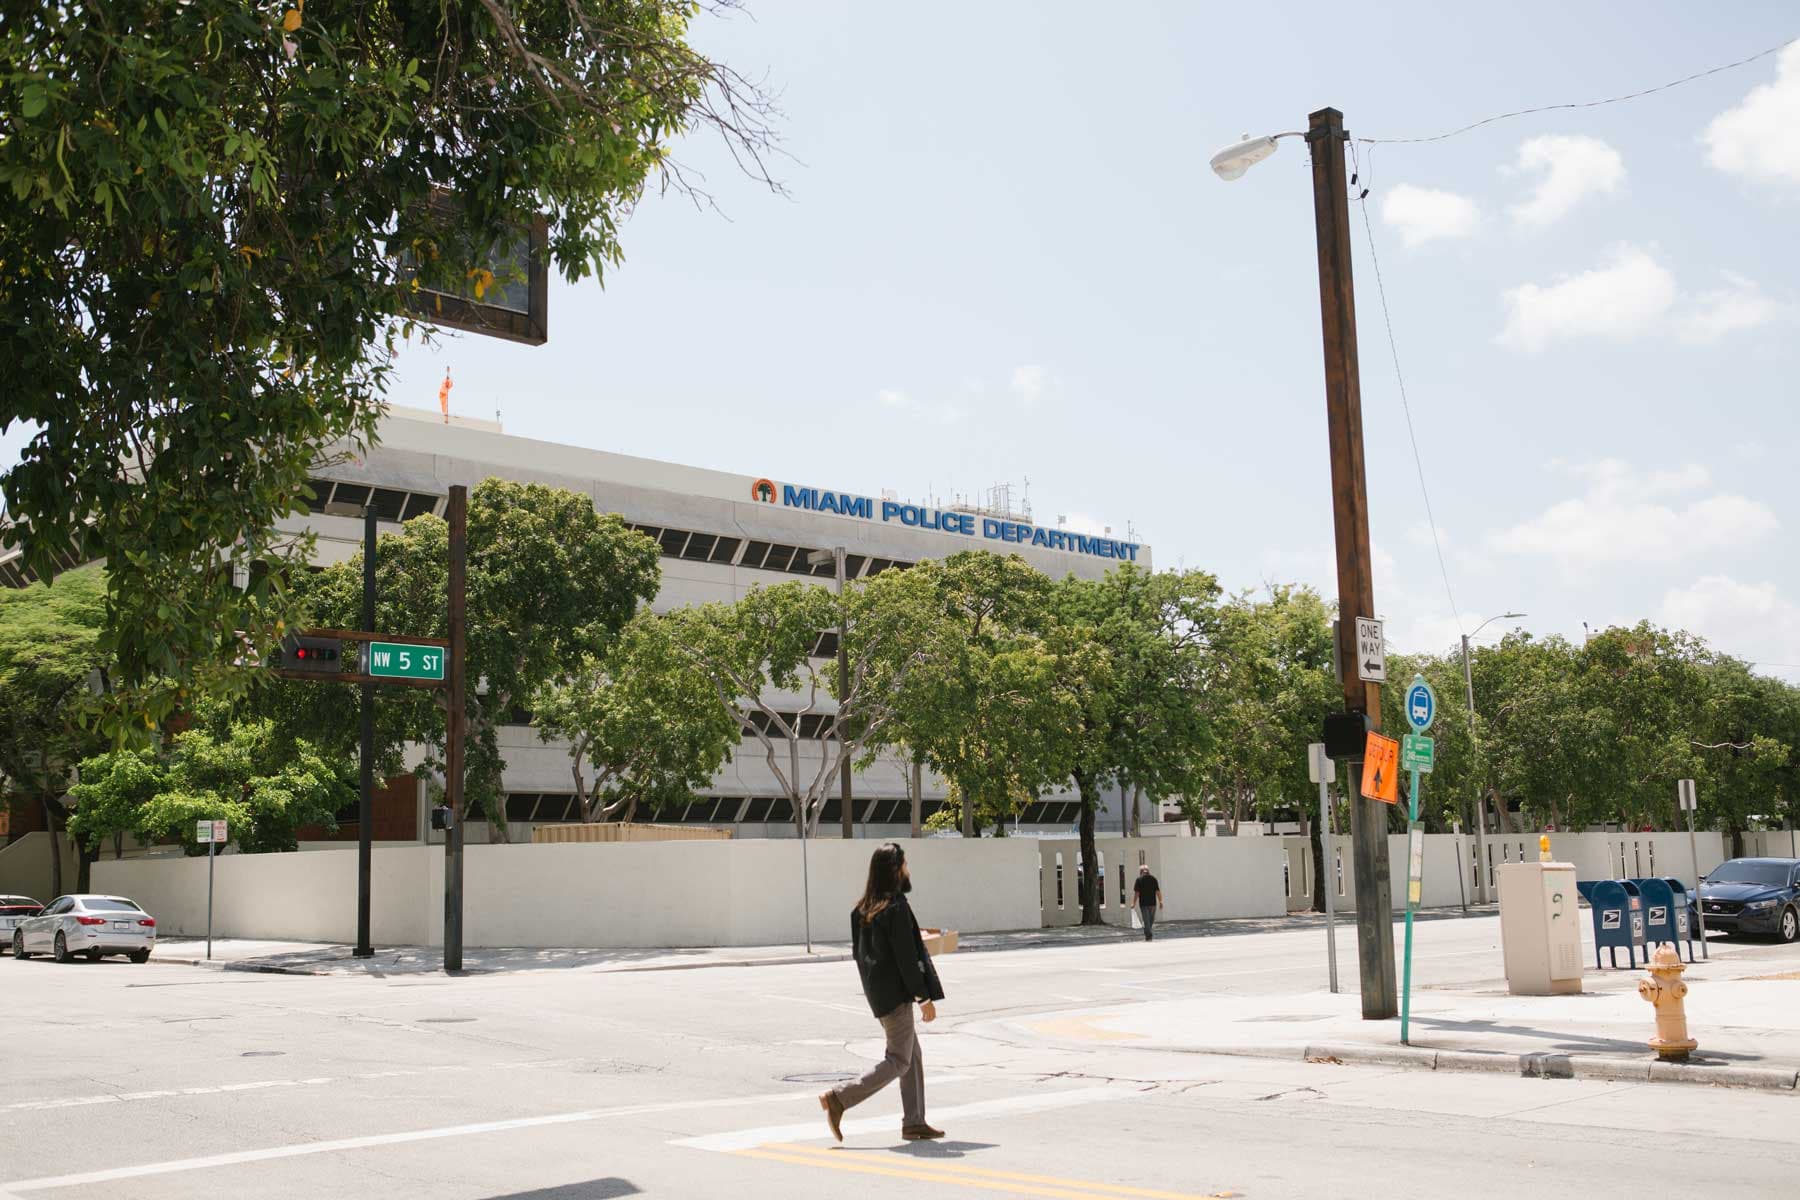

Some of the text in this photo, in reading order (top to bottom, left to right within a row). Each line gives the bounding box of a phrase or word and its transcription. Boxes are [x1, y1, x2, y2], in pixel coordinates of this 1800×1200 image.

[783, 485, 1139, 561] MIAMI POLICE DEPARTMENT
[1360, 624, 1379, 639] ONE
[1361, 640, 1381, 656] WAY
[374, 652, 439, 671] NW 5 ST
